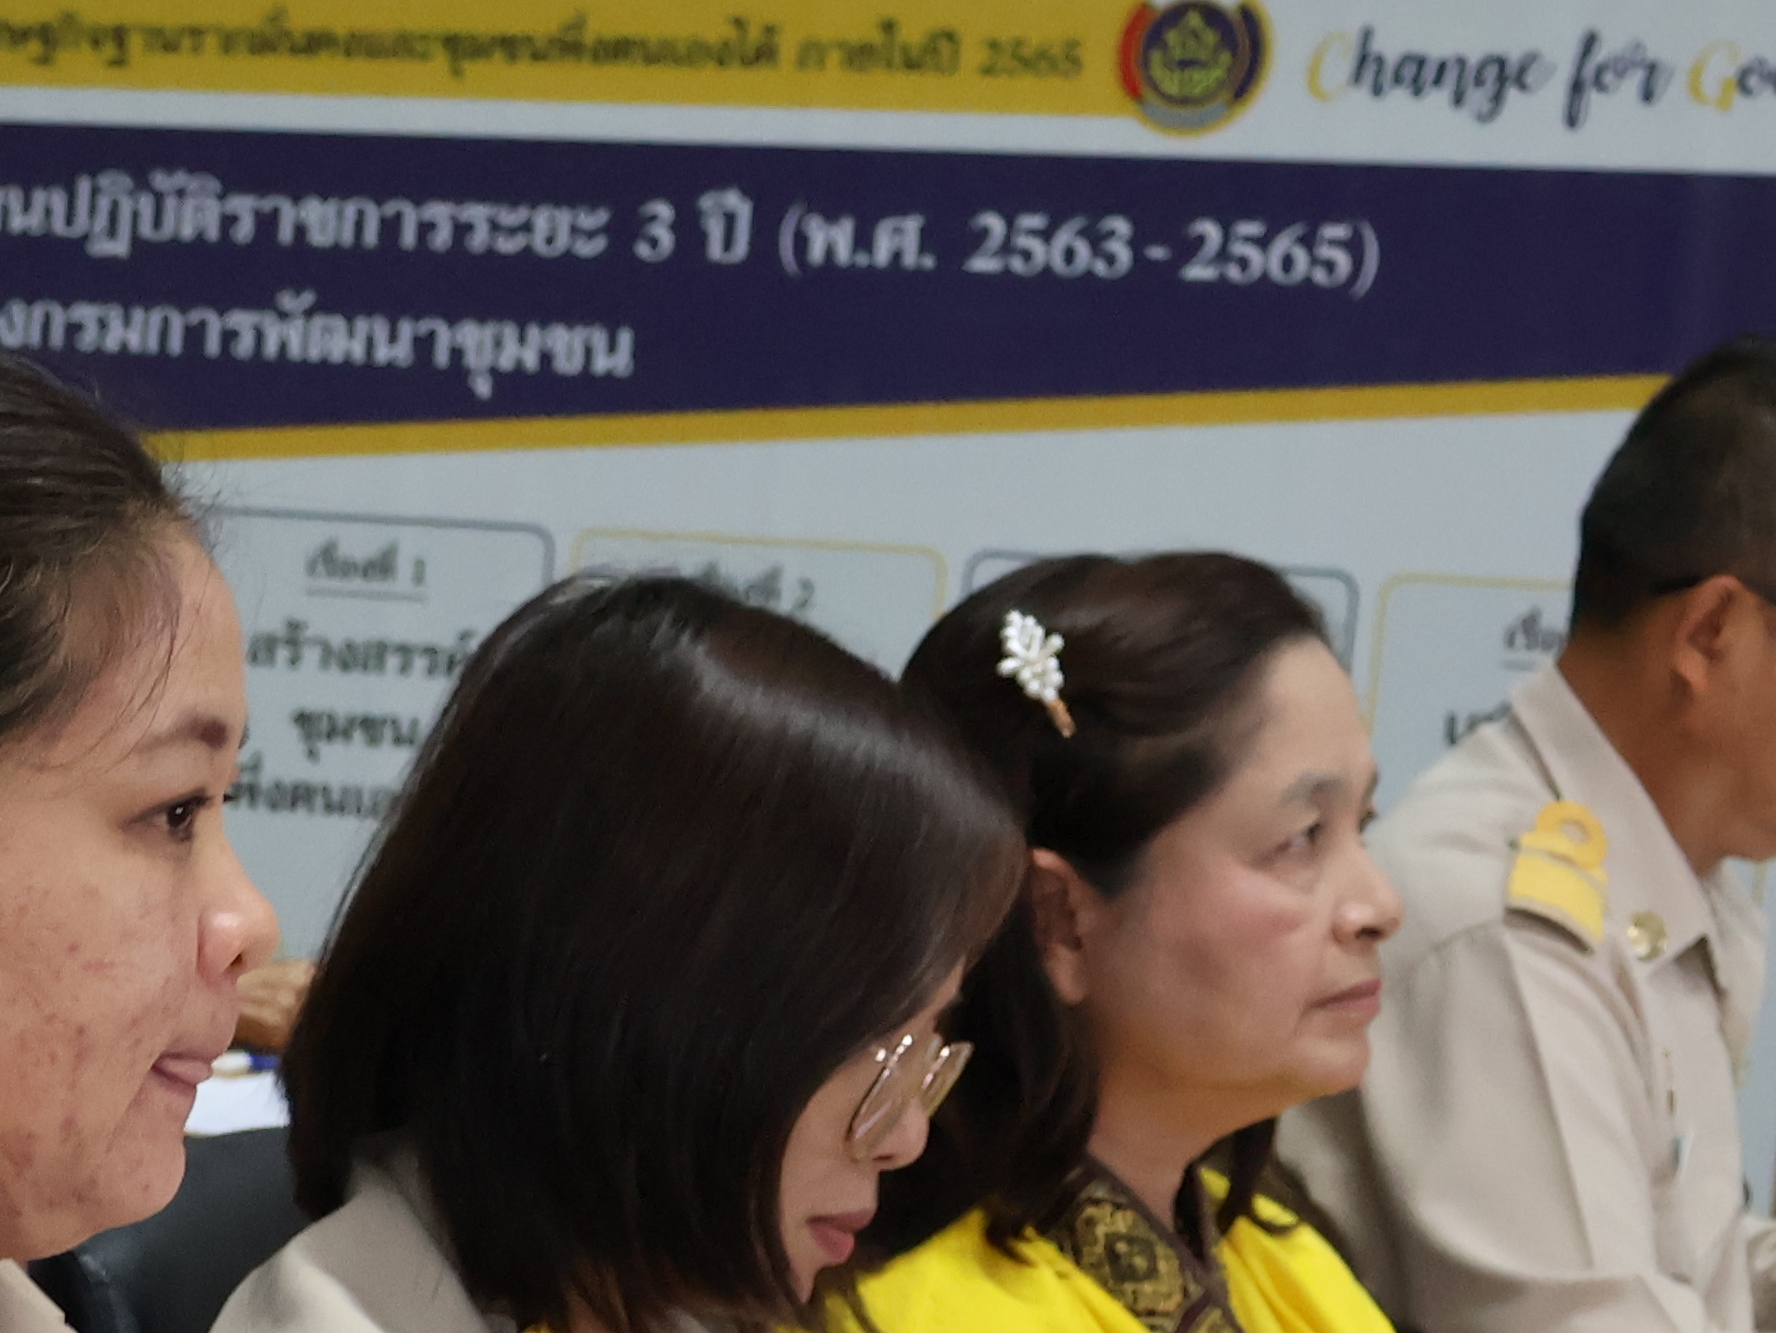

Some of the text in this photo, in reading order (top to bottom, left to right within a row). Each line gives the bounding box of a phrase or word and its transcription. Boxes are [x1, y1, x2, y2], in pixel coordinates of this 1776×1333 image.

[979, 37, 1084, 79] 2565
[1306, 24, 1776, 130] Change for Go
[634, 200, 676, 263] 3
[698, 186, 753, 265] ปี
[778, 203, 936, 277] (พ.ศ.
